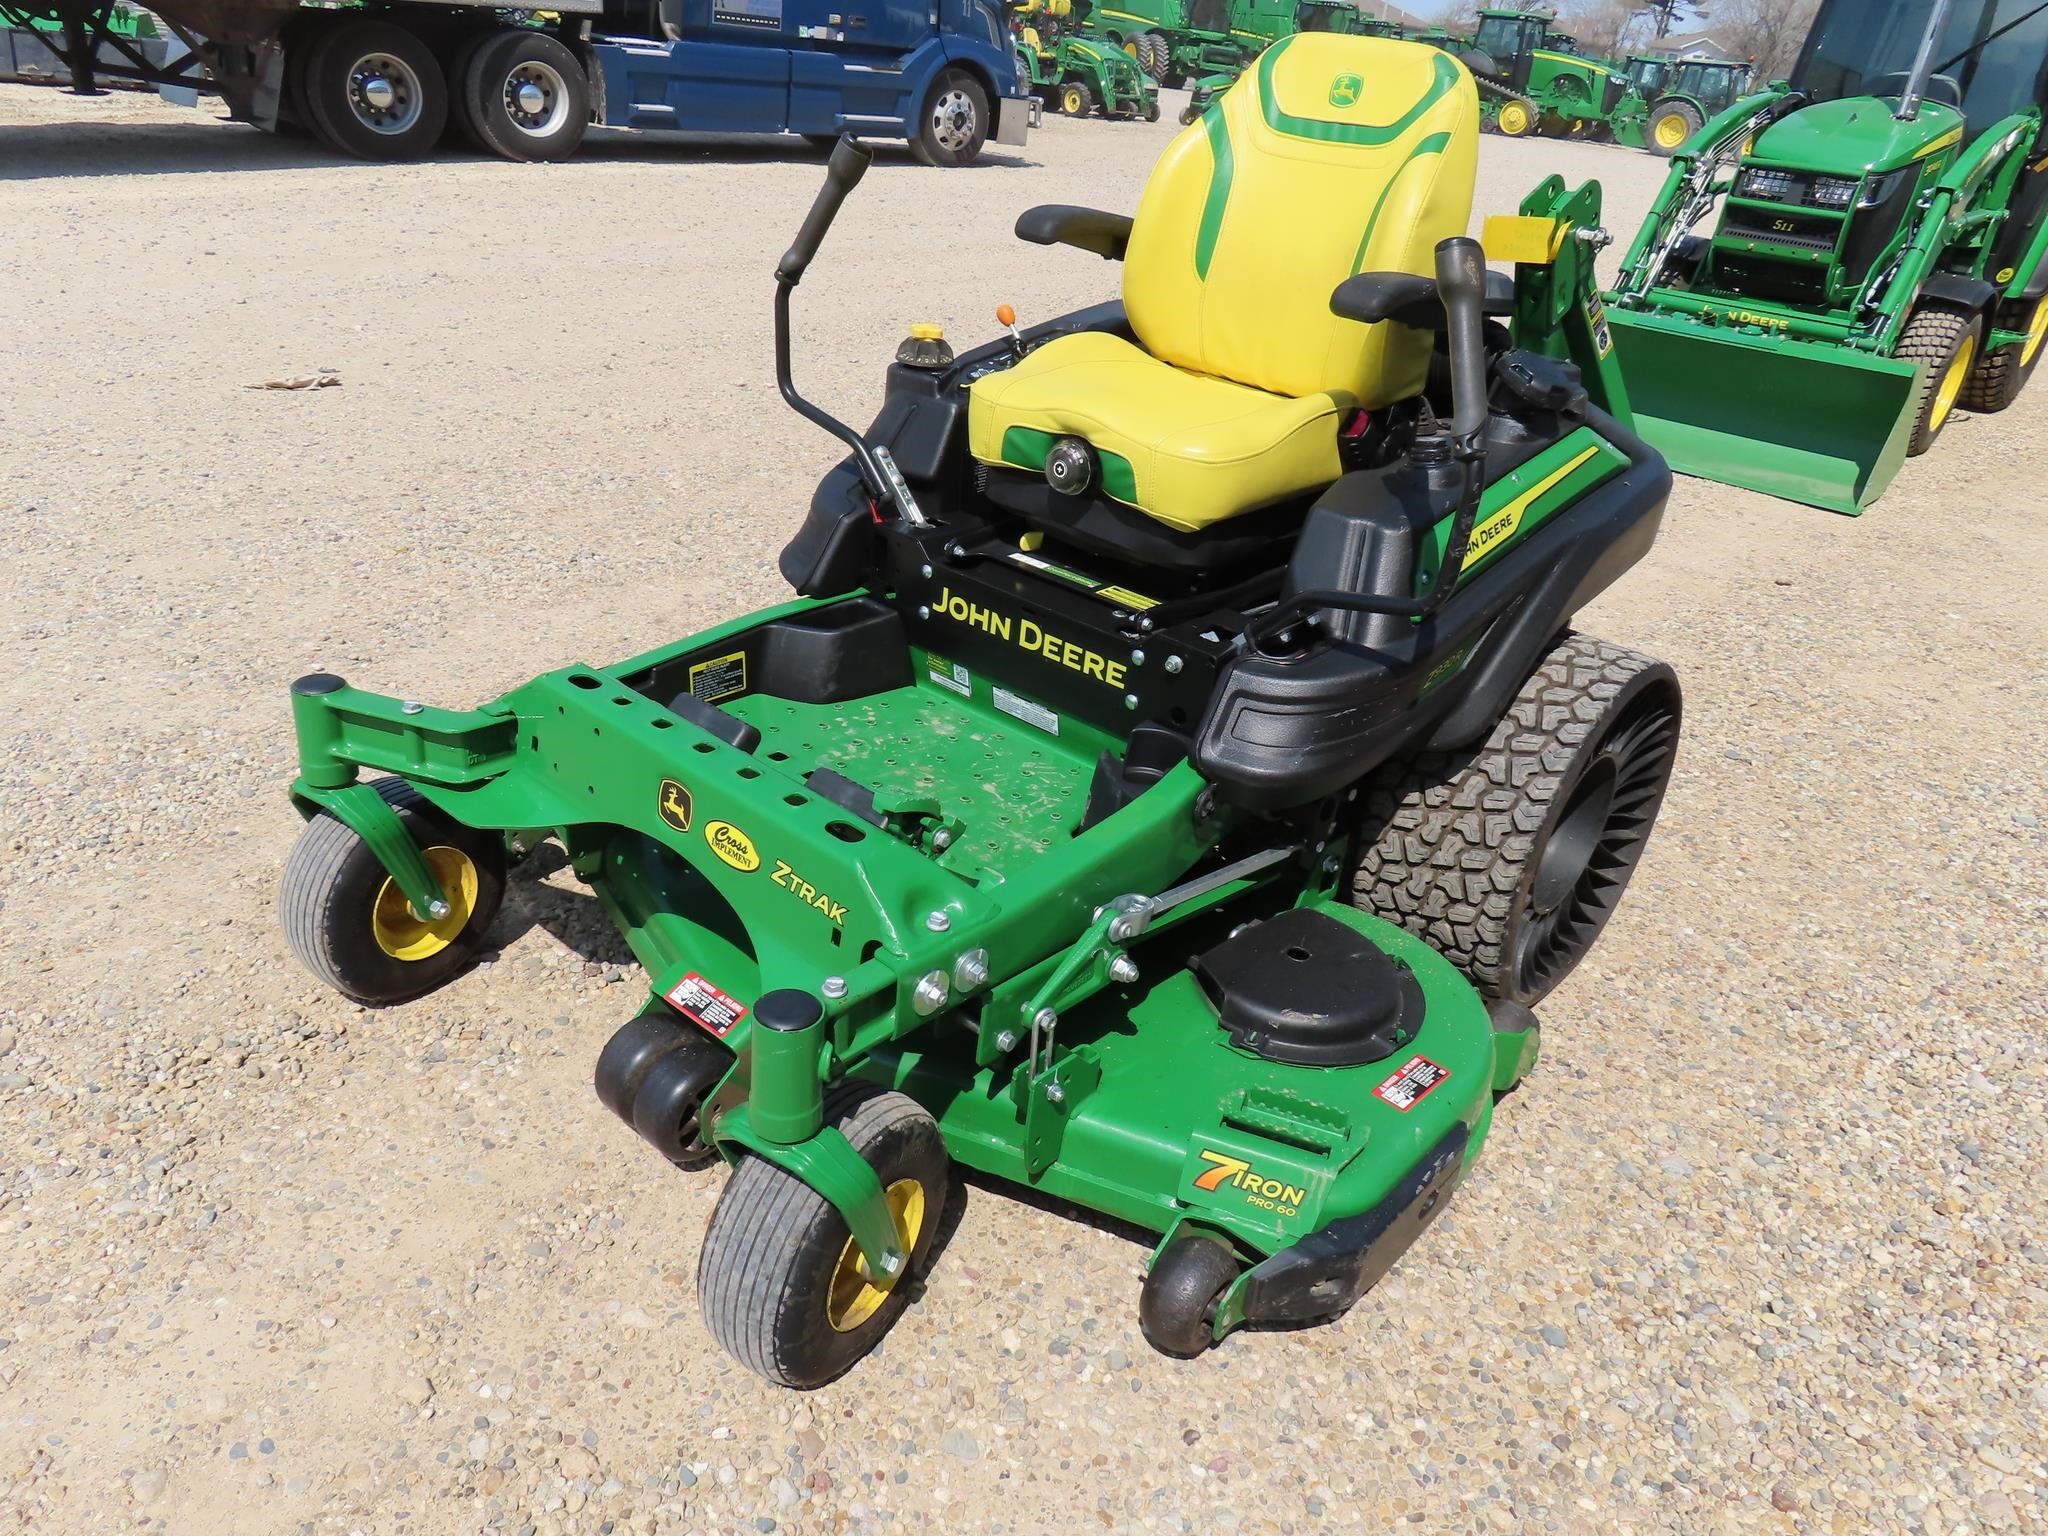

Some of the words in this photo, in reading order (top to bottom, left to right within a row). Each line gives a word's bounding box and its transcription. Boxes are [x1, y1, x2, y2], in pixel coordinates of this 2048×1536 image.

[1740, 311, 1789, 330] DEERE
[1480, 513, 1513, 545] DEERE
[932, 587, 1011, 641] JOHN
[1018, 618, 1127, 690] DEERE
[711, 837, 752, 869] IMPLEMENT
[714, 826, 749, 855] Cross
[769, 858, 850, 928] ZTRAK
[1246, 1195, 1275, 1210] PRO
[1276, 1205, 1296, 1217] 60
